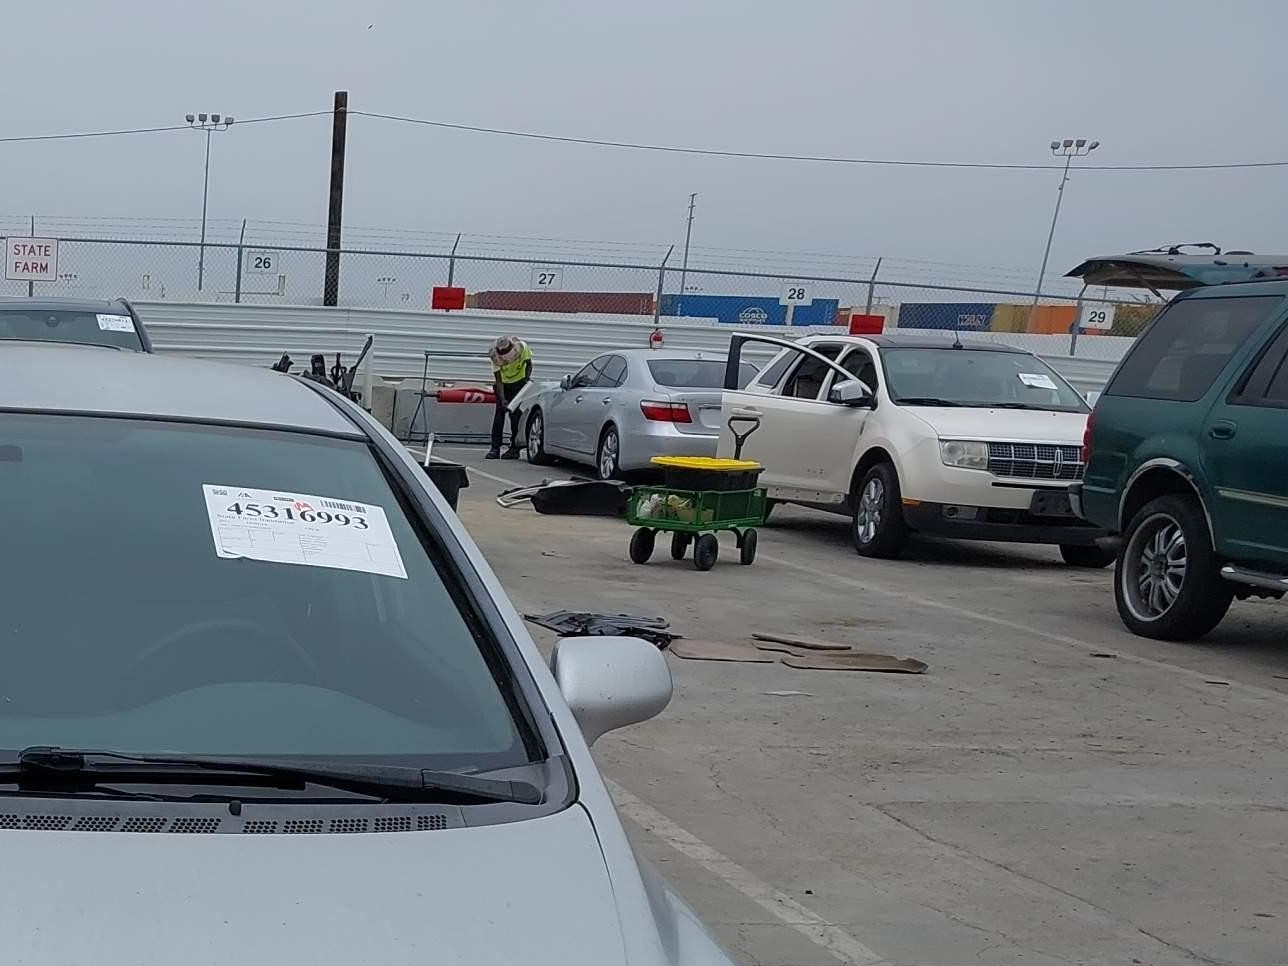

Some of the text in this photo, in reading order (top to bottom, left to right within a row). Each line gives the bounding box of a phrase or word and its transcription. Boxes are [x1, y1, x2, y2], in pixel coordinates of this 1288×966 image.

[13, 244, 51, 256] STATE
[14, 262, 49, 273] FARM
[254, 256, 271, 268] 26
[538, 273, 556, 285] 27
[787, 288, 805, 300] 28
[1088, 311, 1106, 323] 29
[226, 502, 370, 530] 45316993
